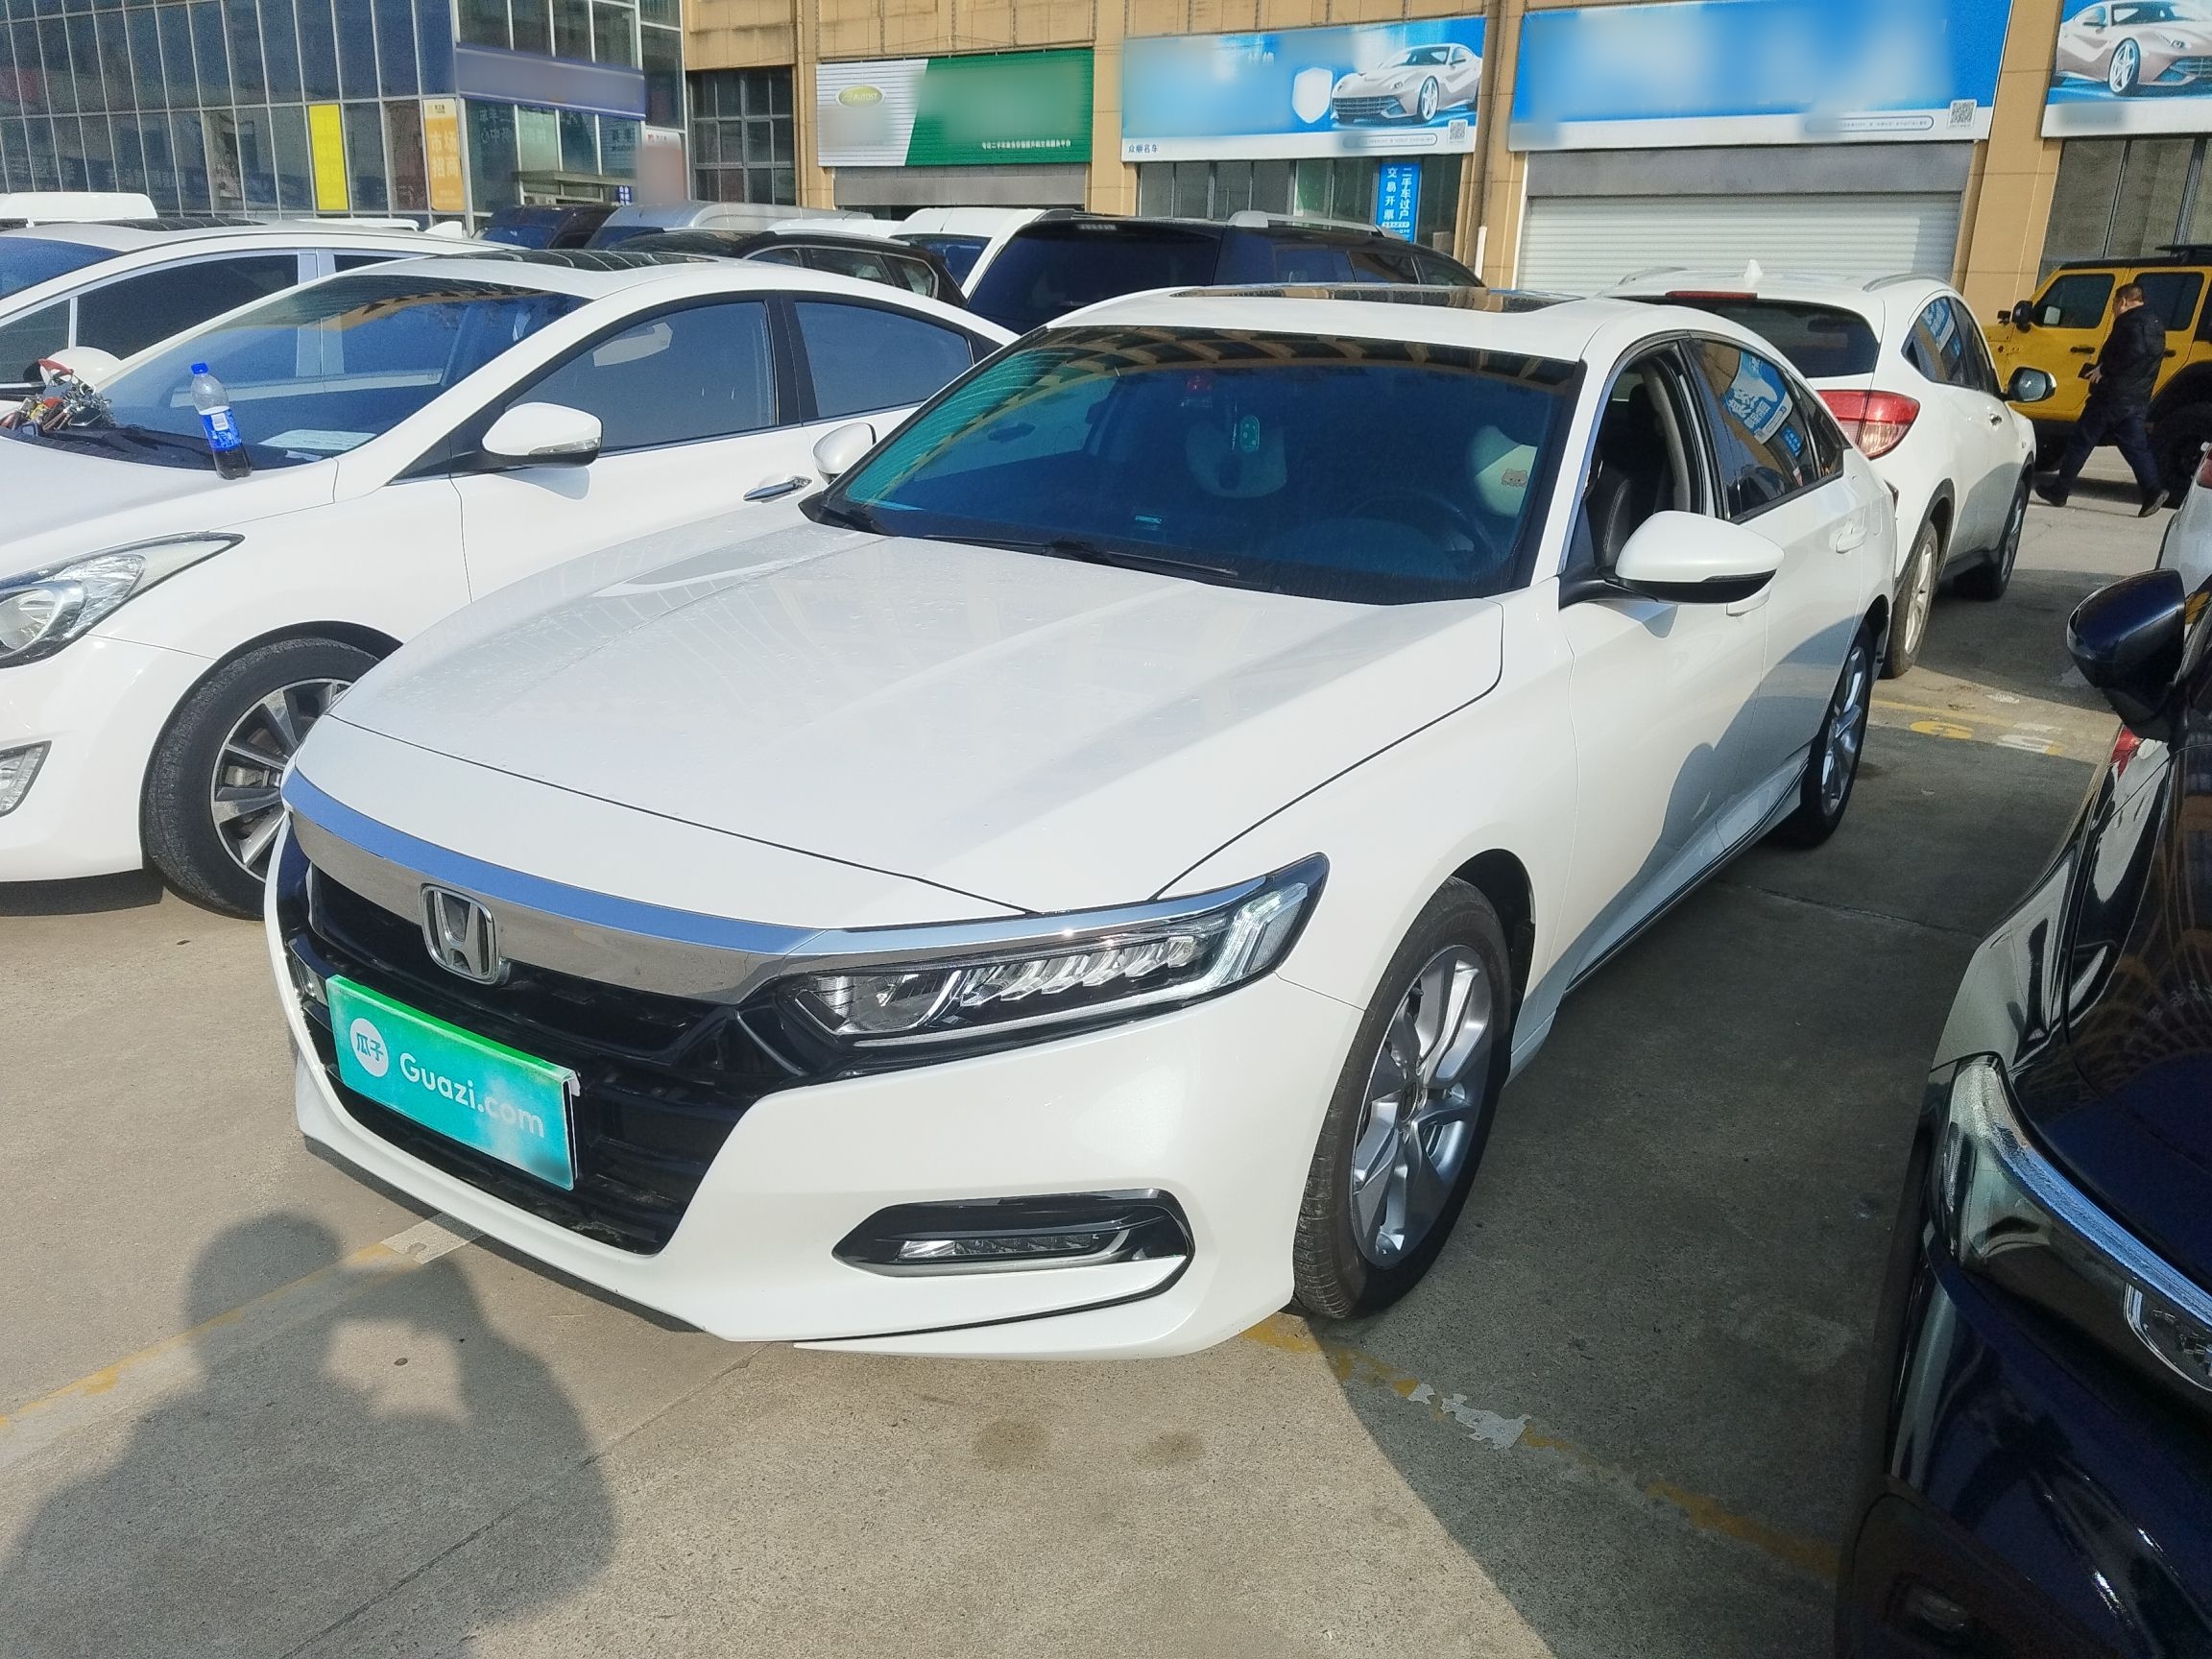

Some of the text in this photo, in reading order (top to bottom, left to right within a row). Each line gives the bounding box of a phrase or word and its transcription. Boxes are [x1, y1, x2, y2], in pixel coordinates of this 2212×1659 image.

[431, 131, 458, 153] 市场
[433, 156, 461, 178] 招商
[1383, 167, 1398, 221] 交易开票
[1399, 167, 1413, 221] 二手车过户
[356, 1031, 384, 1062] 瓜子
[399, 1052, 545, 1139] Guazi.com
